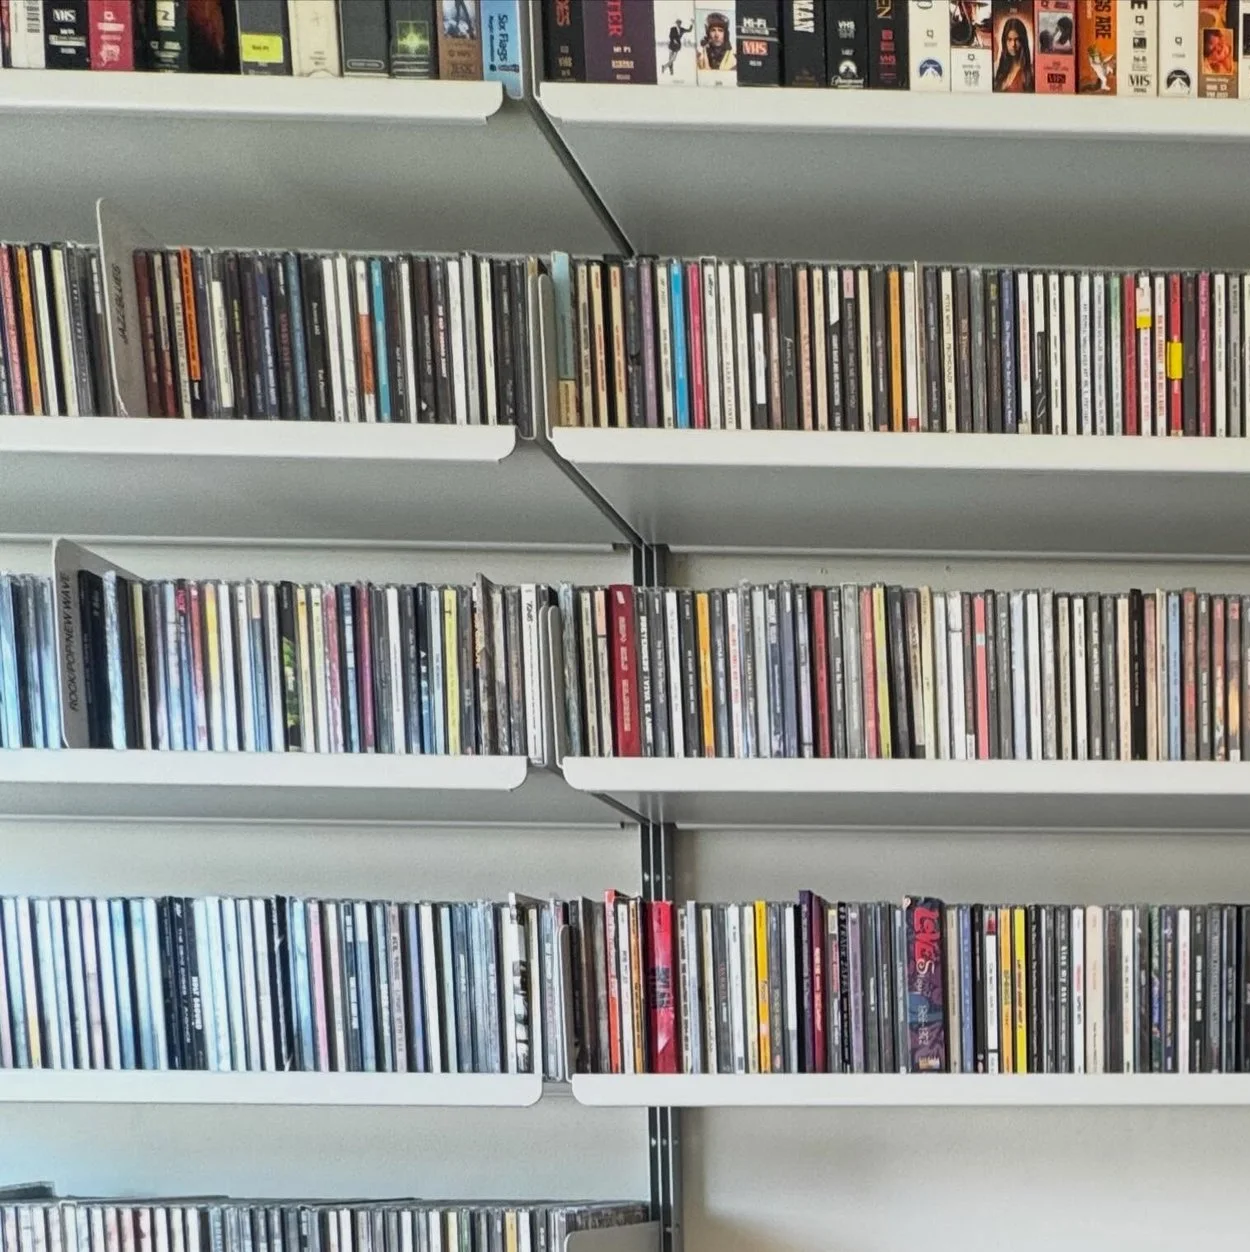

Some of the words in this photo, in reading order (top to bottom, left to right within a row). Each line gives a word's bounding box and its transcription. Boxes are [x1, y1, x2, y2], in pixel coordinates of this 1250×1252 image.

[497, 14, 509, 32] Six
[1095, 16, 1110, 39] ARE
[496, 33, 510, 61] Flags
[743, 40, 768, 55] VHS
[964, 69, 980, 78] VHS
[1130, 74, 1151, 87] VHS
[58, 570, 71, 611] WAVE
[640, 615, 649, 671] PRETENDERS
[913, 907, 941, 965] LOVE
[1061, 945, 1069, 967] kiss
[192, 976, 200, 996] HOLY
[194, 997, 203, 1030] GROUND
